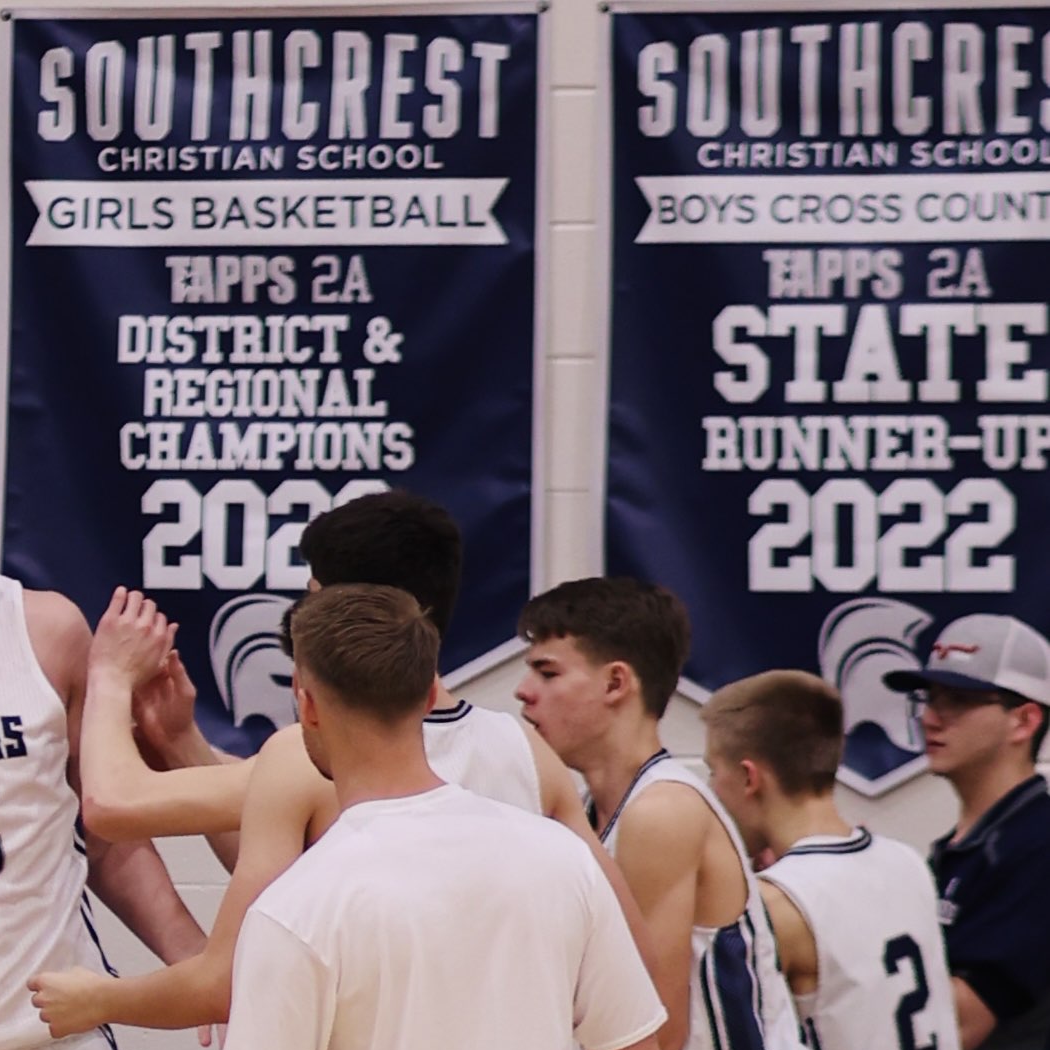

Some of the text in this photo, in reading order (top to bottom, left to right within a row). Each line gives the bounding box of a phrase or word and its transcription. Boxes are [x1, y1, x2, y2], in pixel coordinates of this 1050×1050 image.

[37, 30, 510, 142] SOUTHCREST
[637, 22, 1050, 138] SOUTHCRE
[97, 144, 443, 172] CHRISTIAN SCHOOL
[697, 142, 898, 168] CHRISTIAN
[47, 195, 487, 229] GIRLS BASKETBALL
[657, 191, 1050, 224] BOYS CROSS COUNT
[165, 255, 373, 304] TAPPS 2A
[763, 247, 991, 299] TAPPS 2A
[117, 315, 404, 364] DISTRICT &
[713, 303, 1049, 403] STATE
[143, 369, 387, 417] REGIONAL
[120, 422, 414, 470] CHAMPIONS
[702, 415, 1050, 470] RUNNER-UP
[141, 479, 393, 590] 202
[748, 478, 1016, 592] 2022
